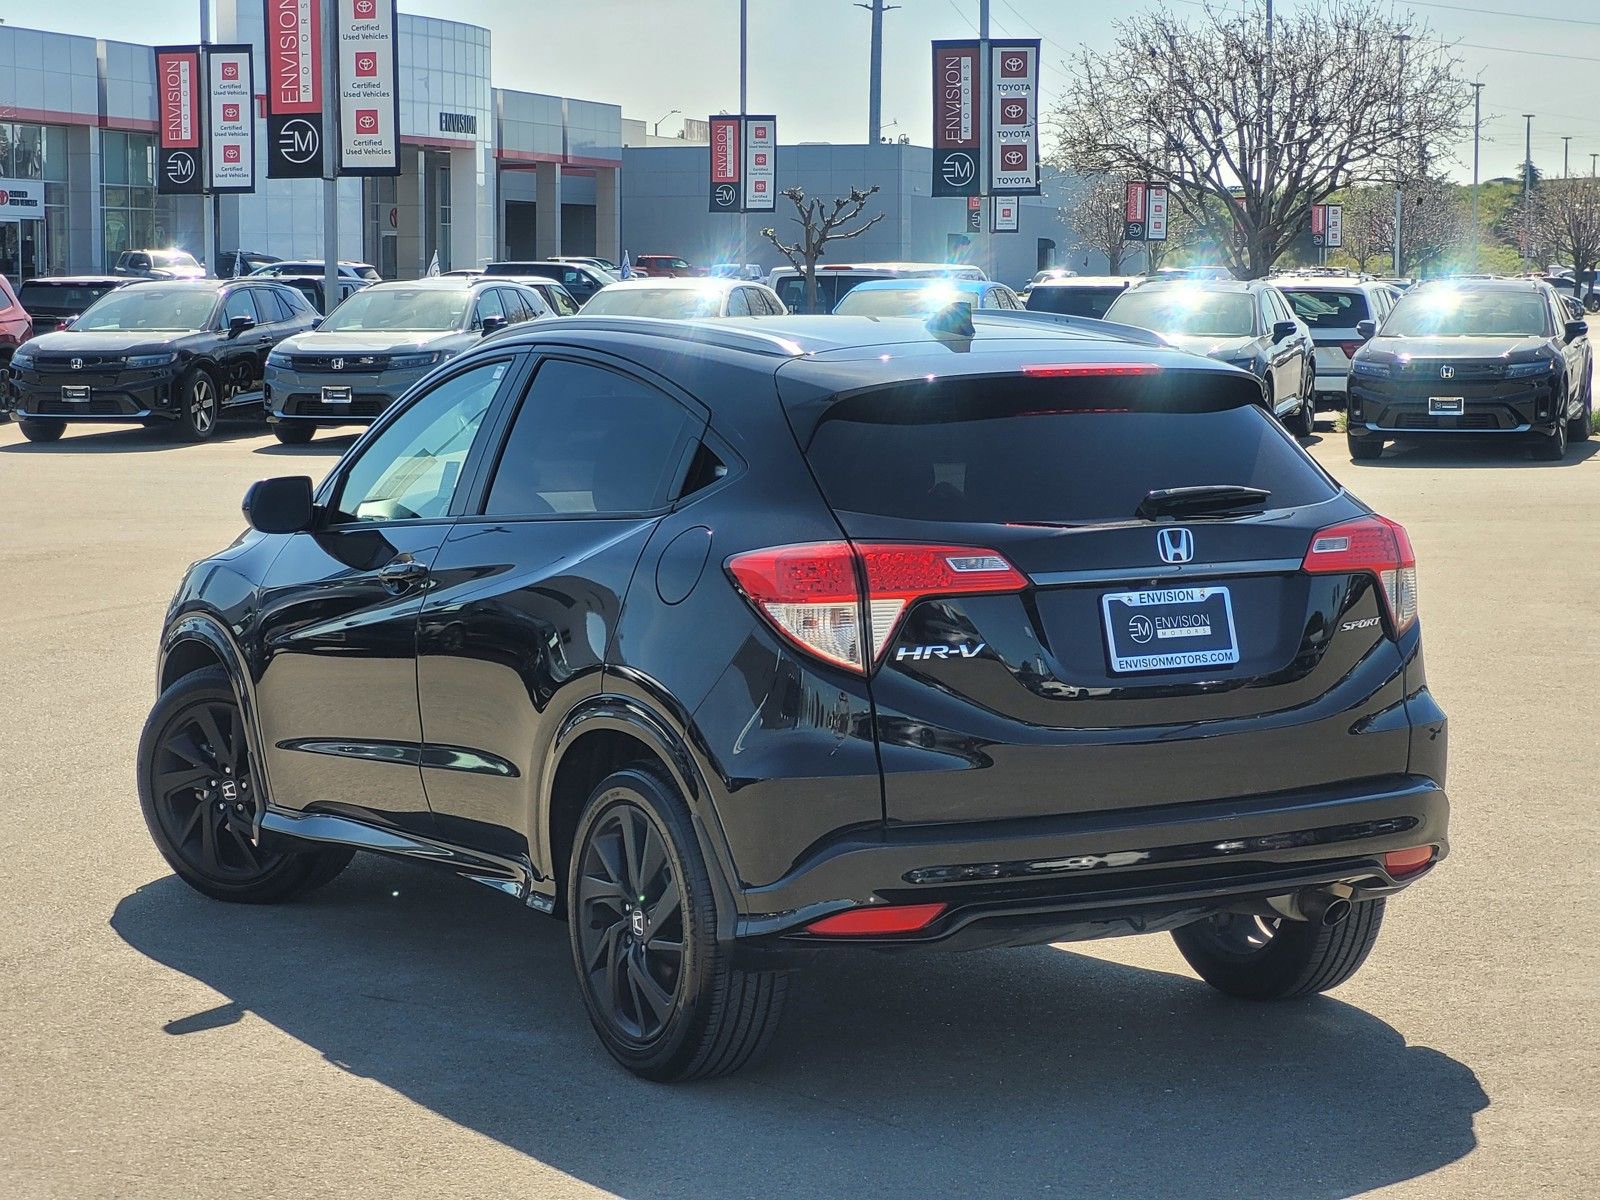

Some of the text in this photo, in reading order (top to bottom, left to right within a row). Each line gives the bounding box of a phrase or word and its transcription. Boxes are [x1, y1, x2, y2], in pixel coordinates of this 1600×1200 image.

[351, 24, 380, 32] Certified
[300, 2, 310, 94] MOTORS
[166, 60, 182, 141] ENVISION
[362, 90, 390, 98] Vehicles
[945, 56, 961, 141] ENVISION
[440, 112, 477, 135] ENVISION
[716, 125, 727, 178] ENVISION
[997, 177, 1031, 185] TOYOTA
[1139, 590, 1194, 603] ENVISION
[1155, 613, 1210, 629] ENVISION
[1340, 616, 1381, 631] SPORT
[1161, 627, 1207, 636] MOTORS
[895, 643, 986, 661] HR-V
[1119, 652, 1234, 669] ENVISIONMOTORS.COM
